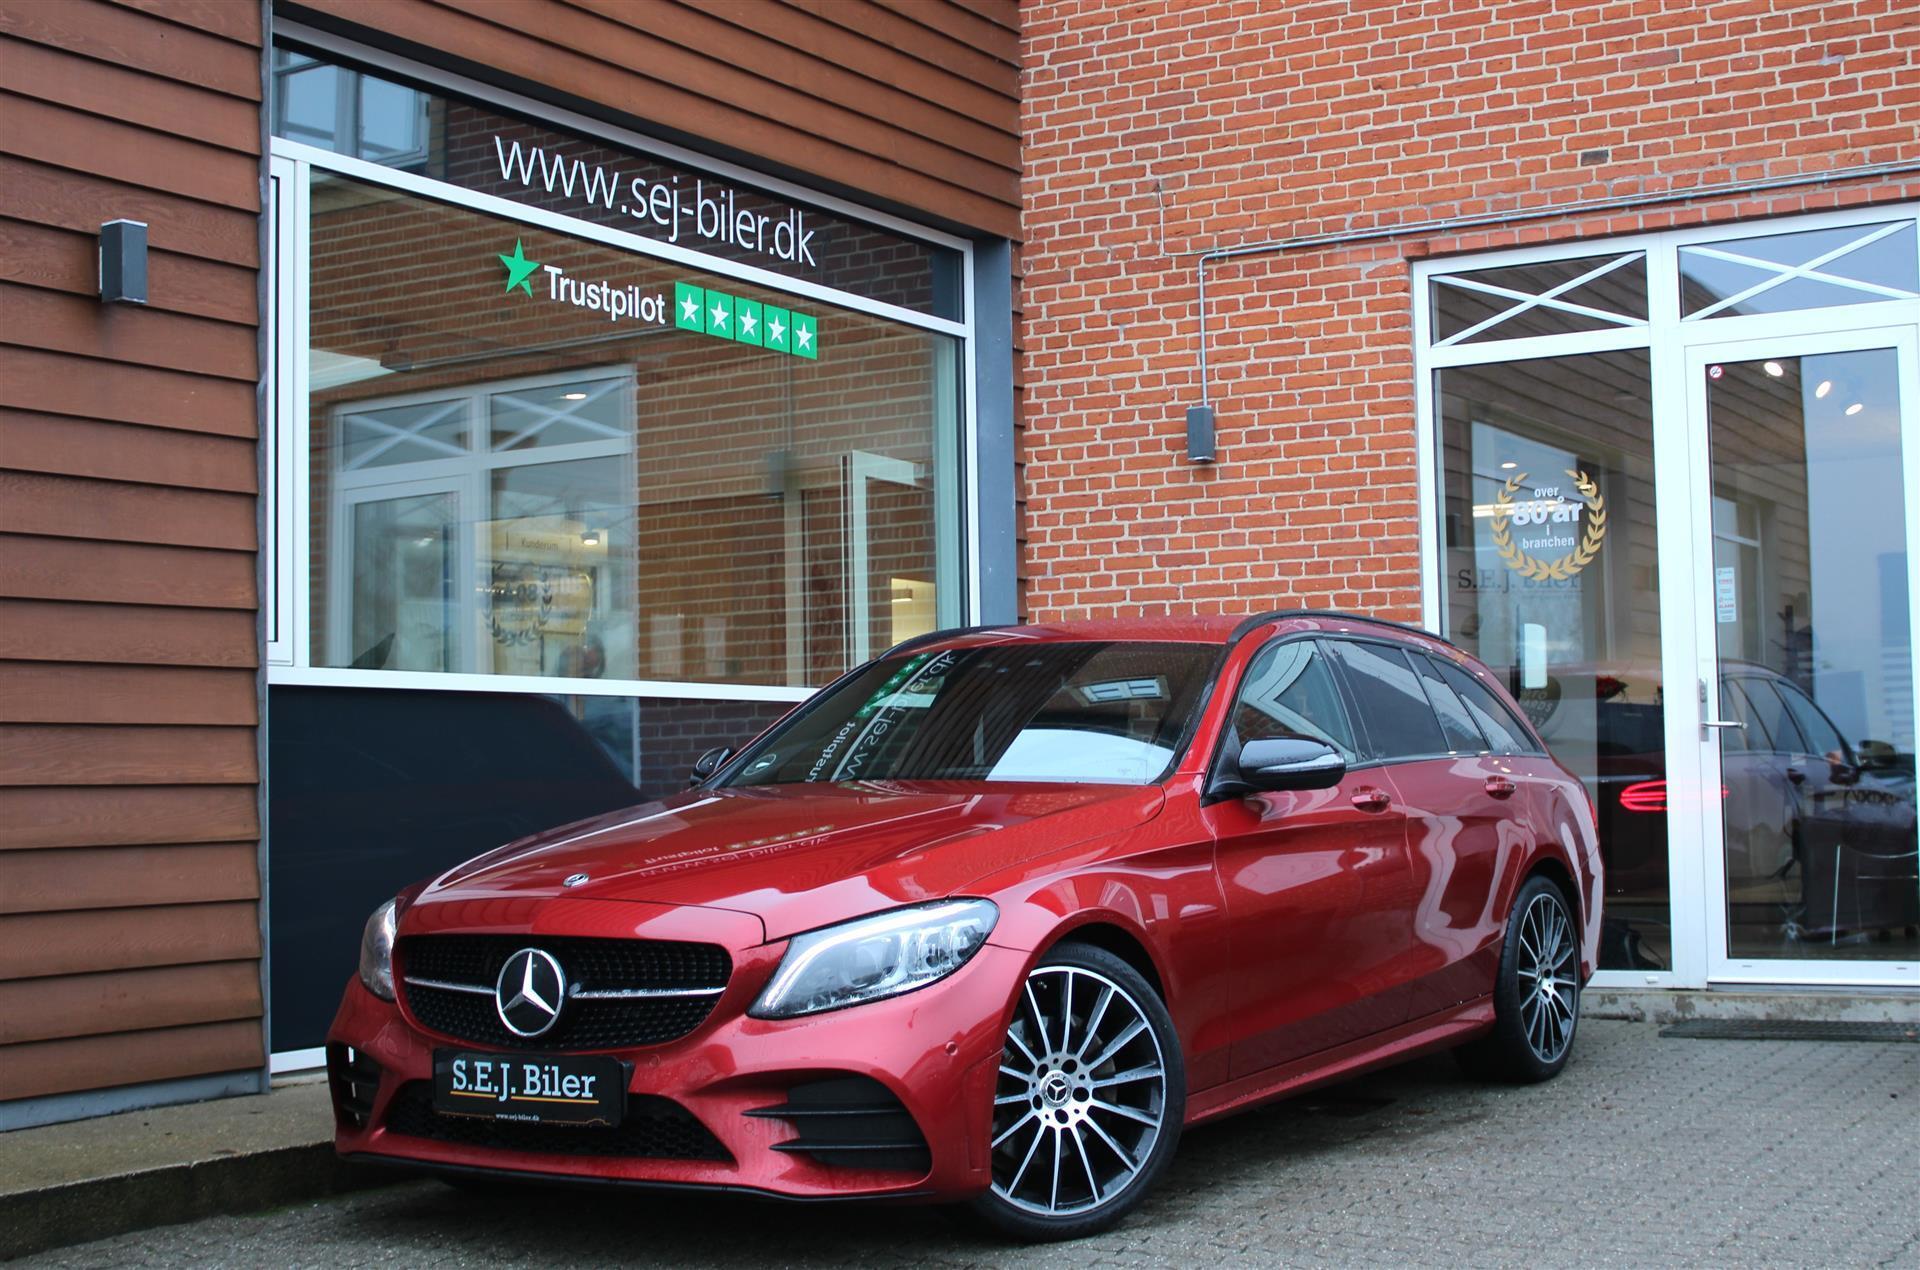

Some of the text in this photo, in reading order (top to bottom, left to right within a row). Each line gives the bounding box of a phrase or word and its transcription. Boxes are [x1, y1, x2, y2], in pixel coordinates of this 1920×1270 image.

[494, 135, 816, 267] www.sej-biler.dk
[544, 264, 665, 325] Trustpilot
[1534, 486, 1559, 498] over
[1512, 495, 1583, 526] 80 år
[1546, 524, 1550, 536] i
[1522, 536, 1575, 549] branchen
[1458, 569, 1516, 593] S.E.J.
[452, 1059, 597, 1102] S.E.J. Biler
[495, 1112, 540, 1122] www.sej-biler.dk
